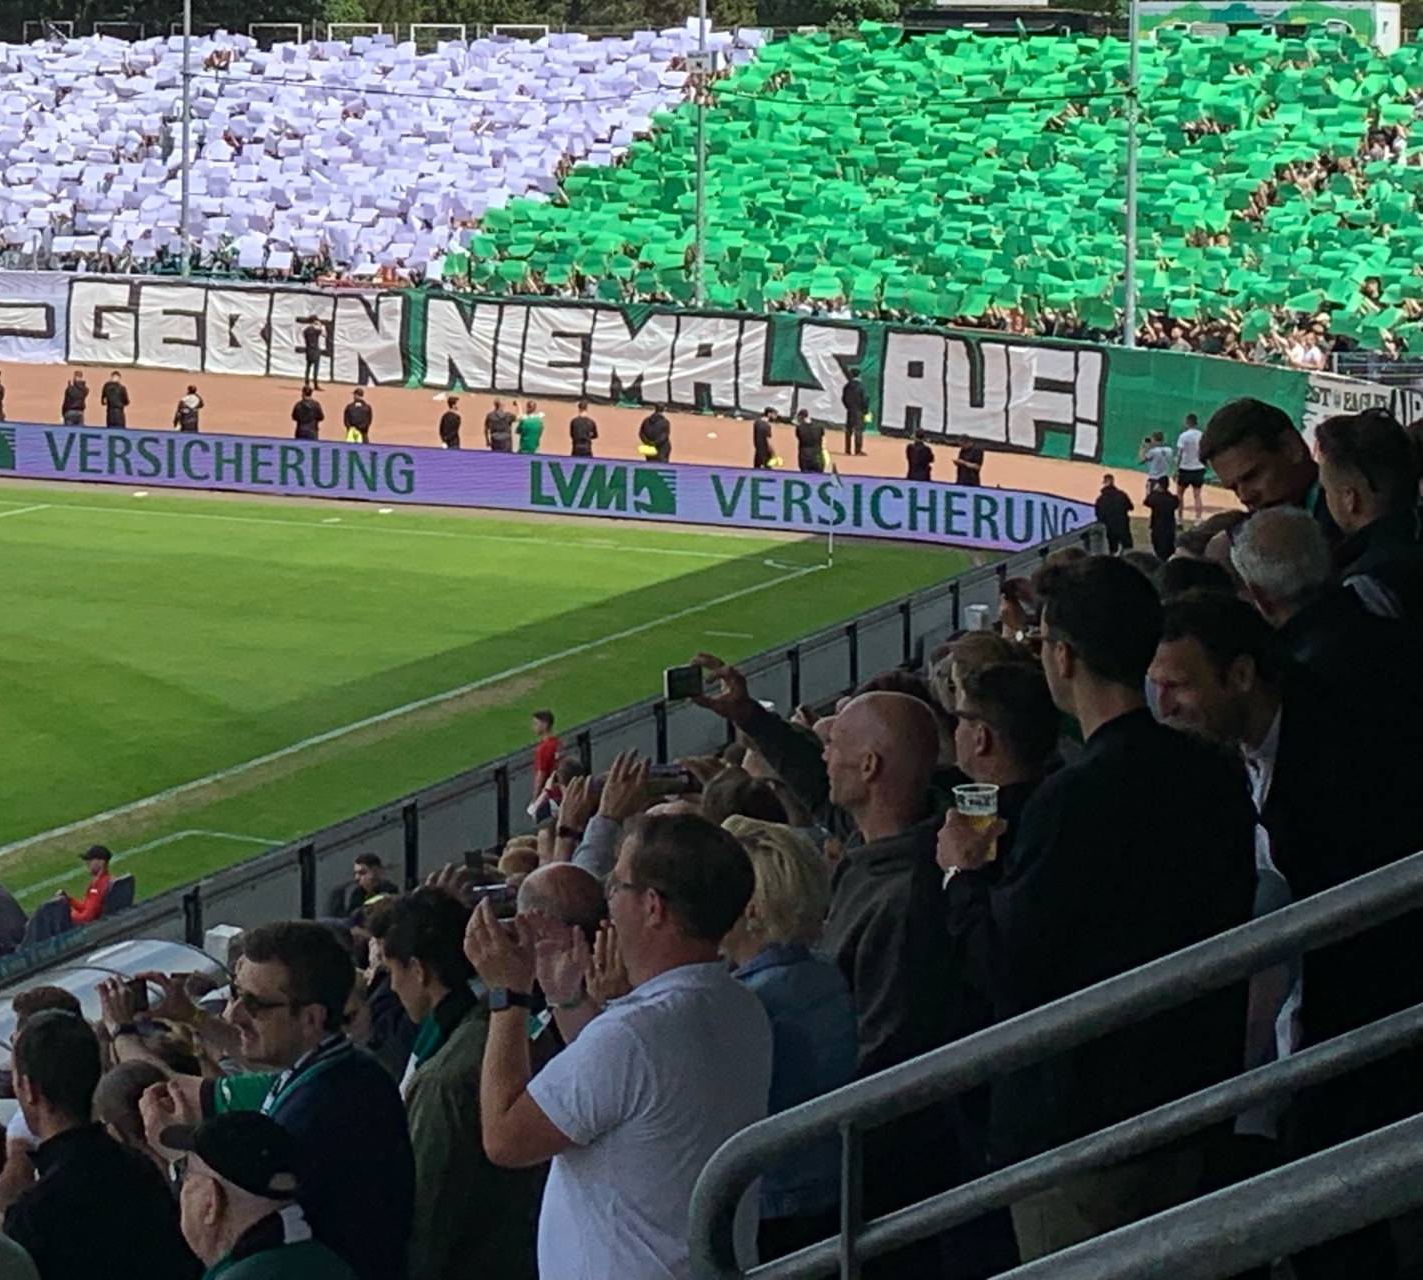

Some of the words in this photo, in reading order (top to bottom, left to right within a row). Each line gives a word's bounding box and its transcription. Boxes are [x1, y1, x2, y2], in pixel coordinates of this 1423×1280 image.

[68, 277, 405, 386] GEBEN
[423, 298, 867, 430] NIEMALS
[880, 326, 1107, 463] AUF!
[44, 431, 415, 495] VERSICHERUNG
[530, 461, 633, 511] LVM
[712, 473, 1079, 544] VERSICHERUNG
